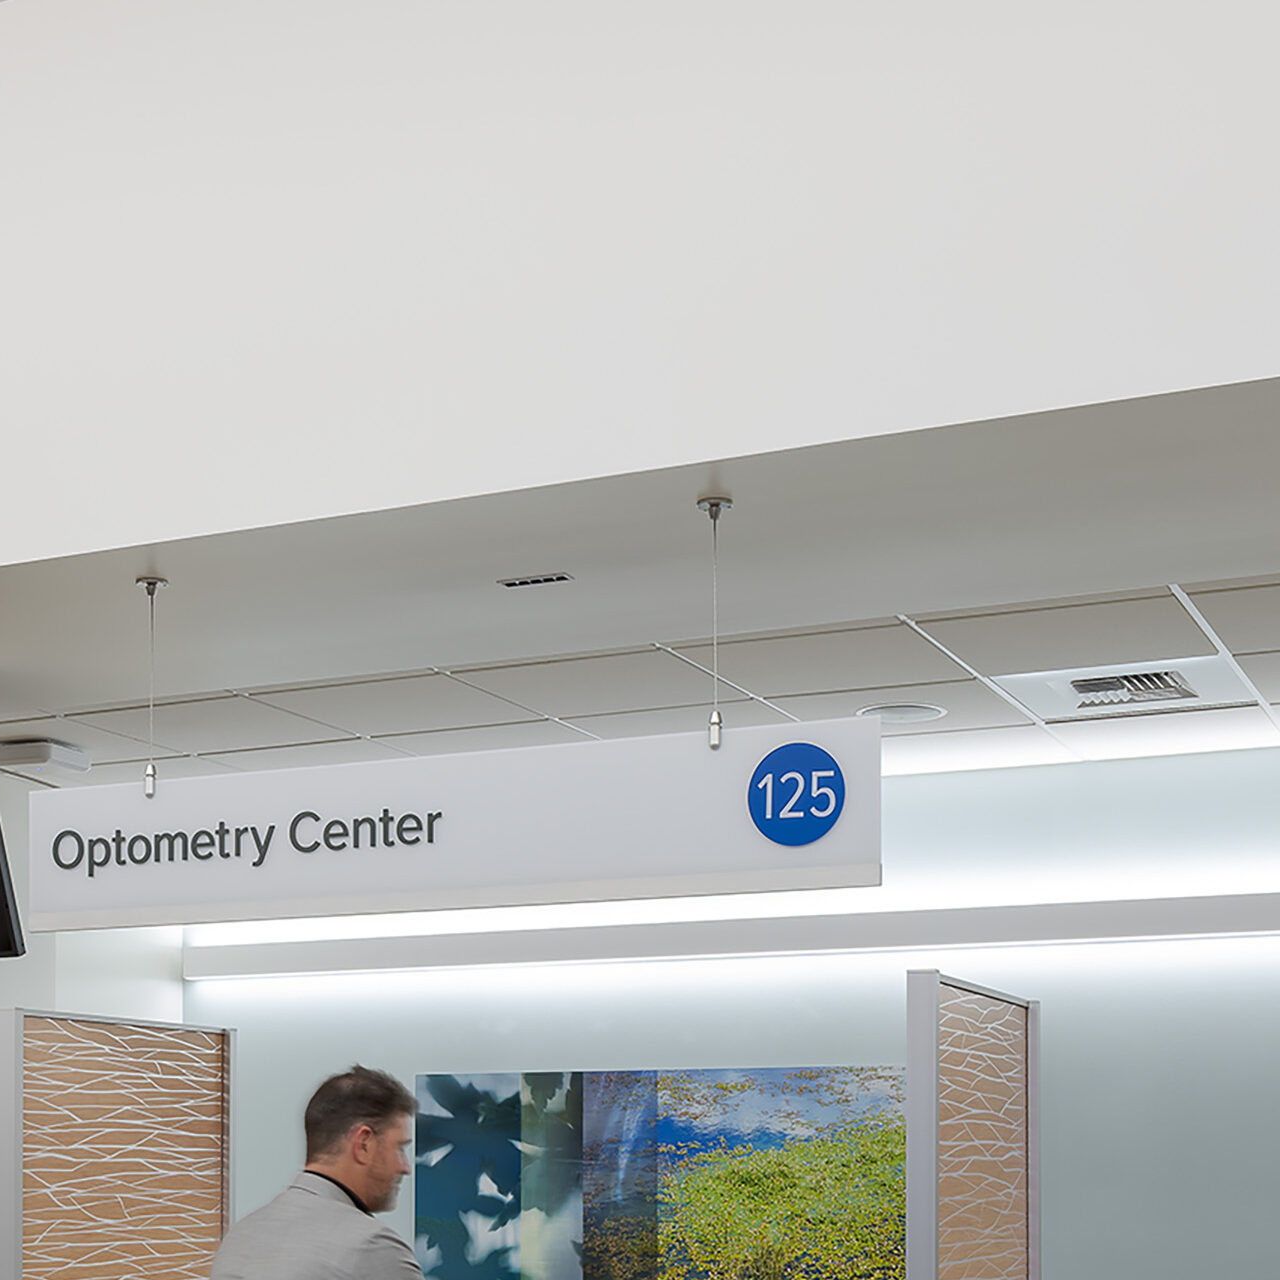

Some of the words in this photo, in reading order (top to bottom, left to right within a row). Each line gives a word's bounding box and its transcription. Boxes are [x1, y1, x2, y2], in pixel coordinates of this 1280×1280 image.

[757, 770, 837, 819] 125
[51, 821, 276, 878] Optometry
[289, 808, 442, 853] Center
